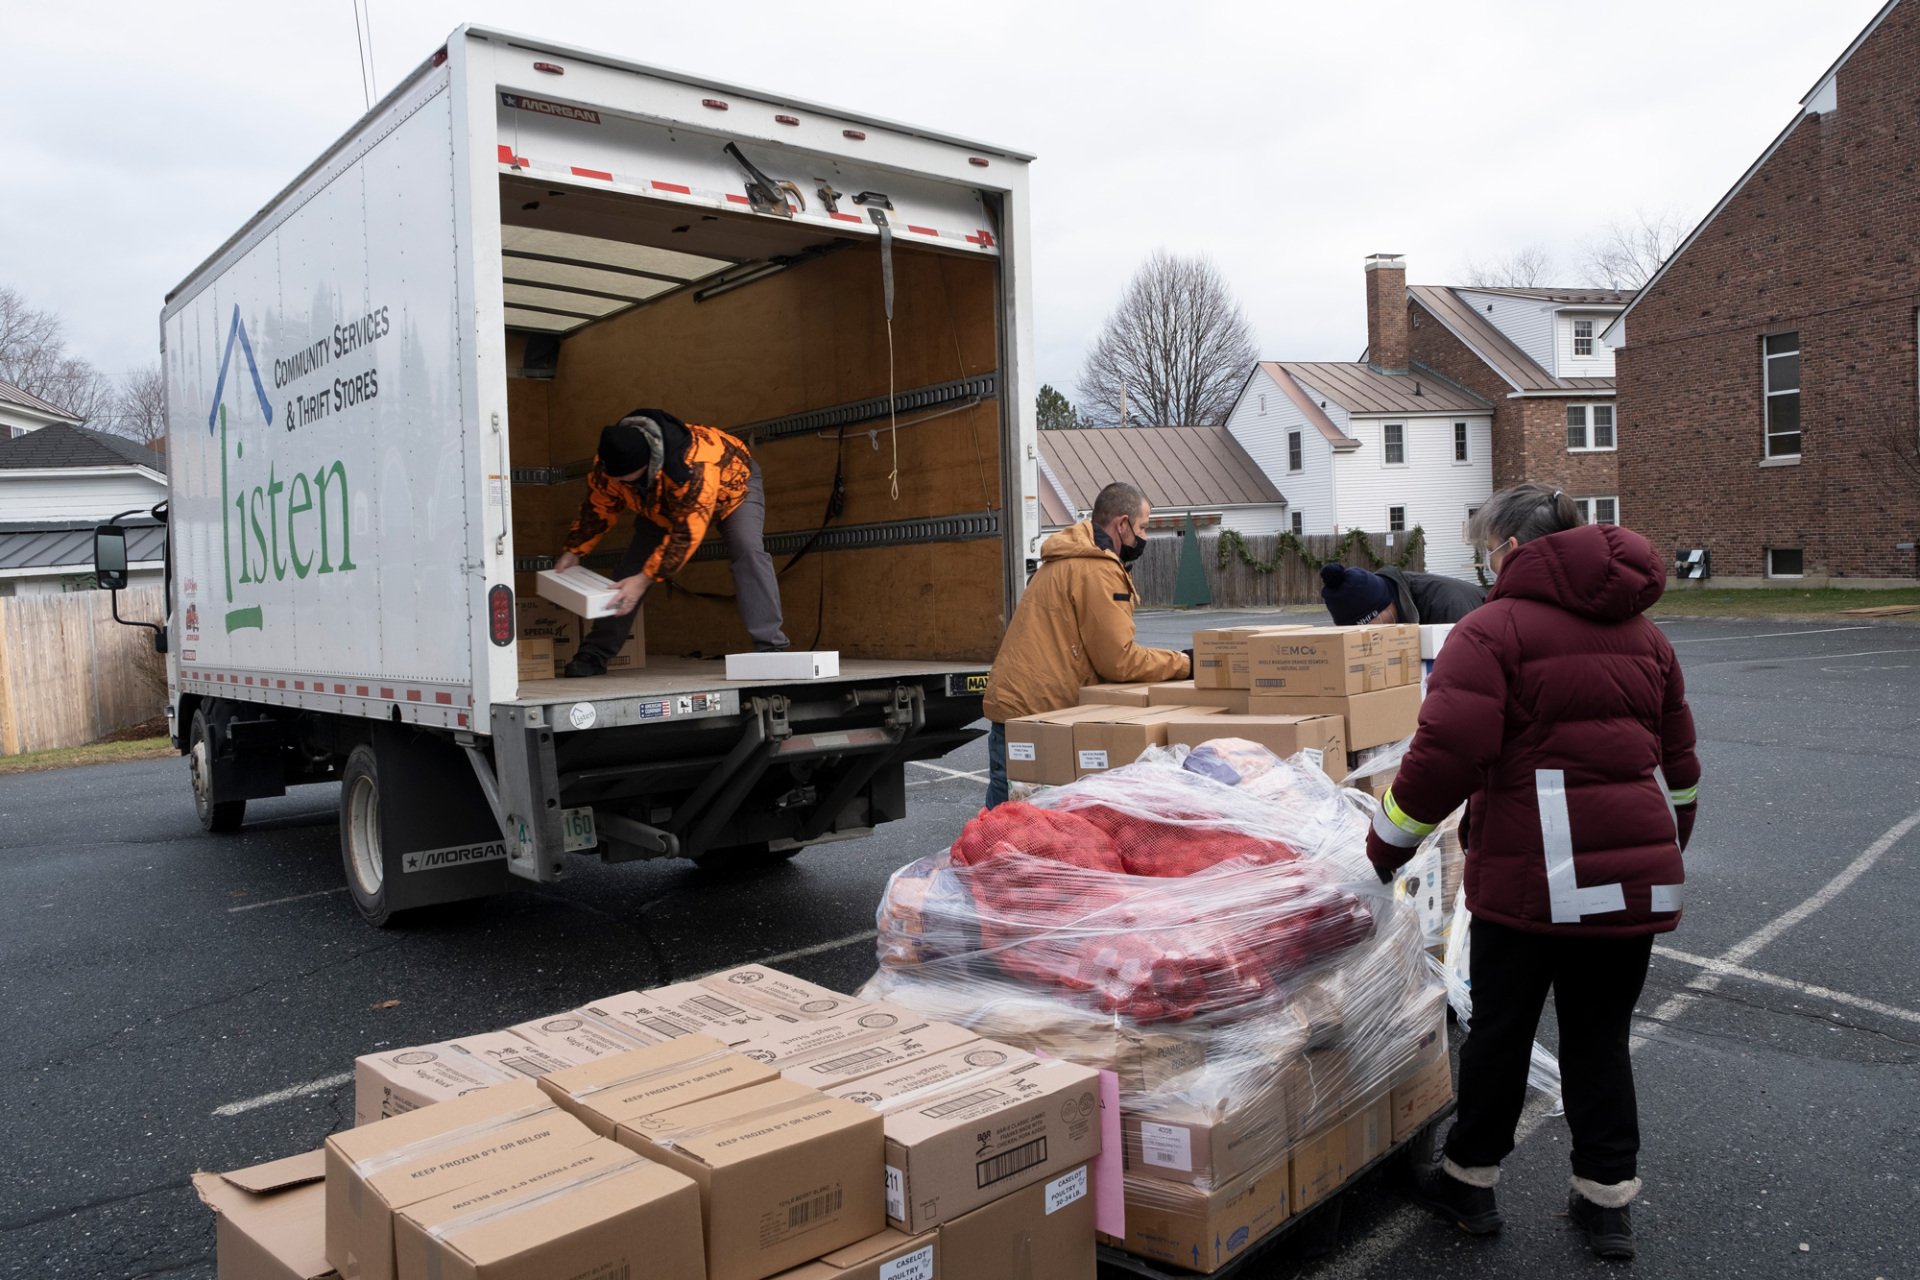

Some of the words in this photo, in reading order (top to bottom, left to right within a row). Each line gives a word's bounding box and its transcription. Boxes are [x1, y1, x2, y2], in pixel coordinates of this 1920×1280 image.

[522, 99, 596, 122] MORGAN
[274, 336, 330, 389] COMMUNITY
[334, 306, 390, 358] SERVICES
[286, 400, 296, 432] &
[297, 388, 330, 427] THRIFT
[334, 368, 378, 412] STORES
[220, 402, 356, 604] listen
[566, 814, 592, 837] 160
[426, 844, 506, 866] MORGAN
[885, 1055, 904, 1064] BOX
[622, 1094, 643, 1103] KEEP
[644, 1084, 678, 1096] FROZEN
[706, 1067, 733, 1078] BELOW
[1001, 1096, 1022, 1106] BOX
[715, 1138, 738, 1147] KEEP
[739, 1127, 774, 1140] FROZEN
[803, 1109, 832, 1121] BELOW
[411, 1167, 437, 1179] KEEP
[440, 1153, 480, 1170] FROZEN
[500, 1142, 515, 1151] OR
[516, 1130, 551, 1146] BELOW
[570, 1156, 594, 1168] KEEP
[528, 1166, 568, 1183] FROZEN
[1058, 1171, 1082, 1187] CASELOT
[492, 1188, 508, 1196] OR
[1051, 1184, 1076, 1200] POULTRY
[452, 1194, 490, 1210] BELOW
[896, 1250, 926, 1268] CASELOT
[888, 1266, 918, 1280] POULTRY
